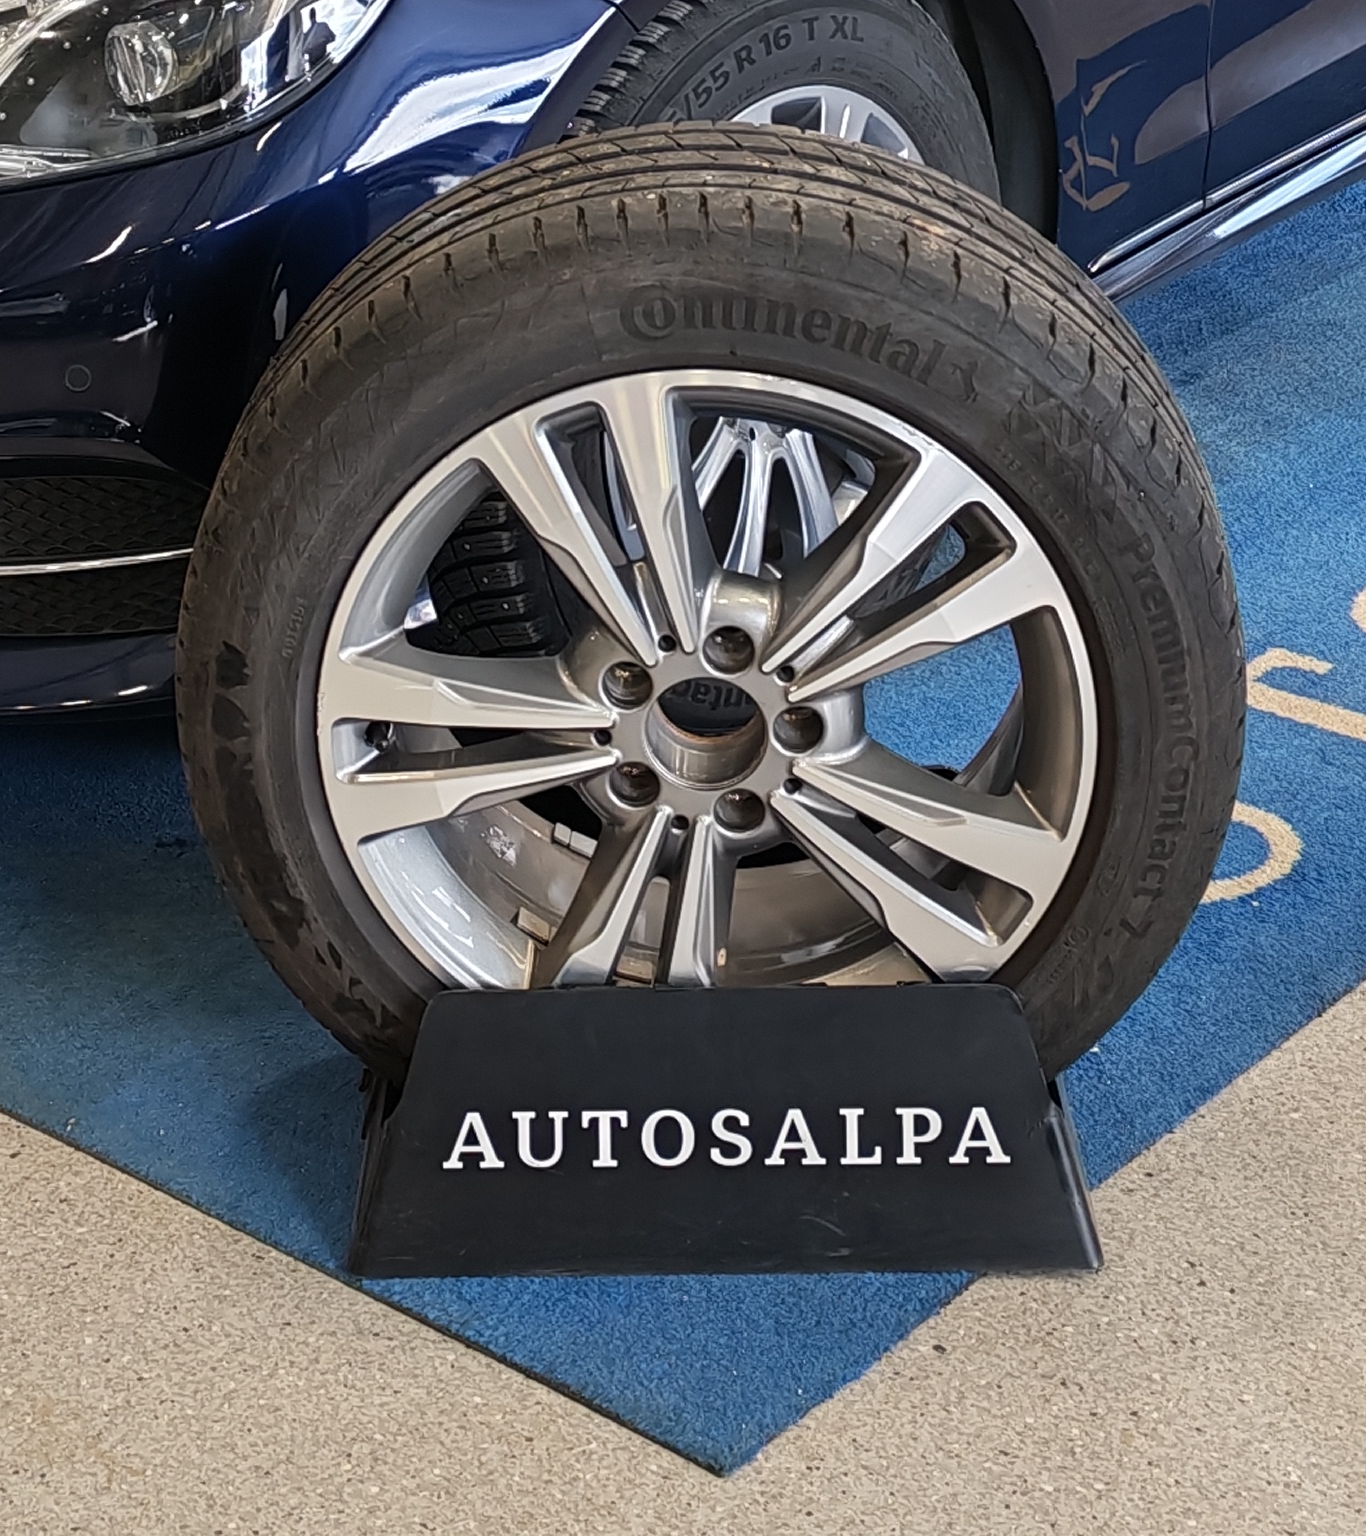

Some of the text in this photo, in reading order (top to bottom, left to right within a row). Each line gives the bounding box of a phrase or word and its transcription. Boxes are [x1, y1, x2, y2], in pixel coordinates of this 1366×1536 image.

[734, 44, 757, 74] R
[758, 23, 793, 57] 16
[800, 17, 820, 42] T
[828, 15, 866, 43] XL
[619, 276, 946, 386] Continental
[442, 1106, 1011, 1170] AUTOSALPA
